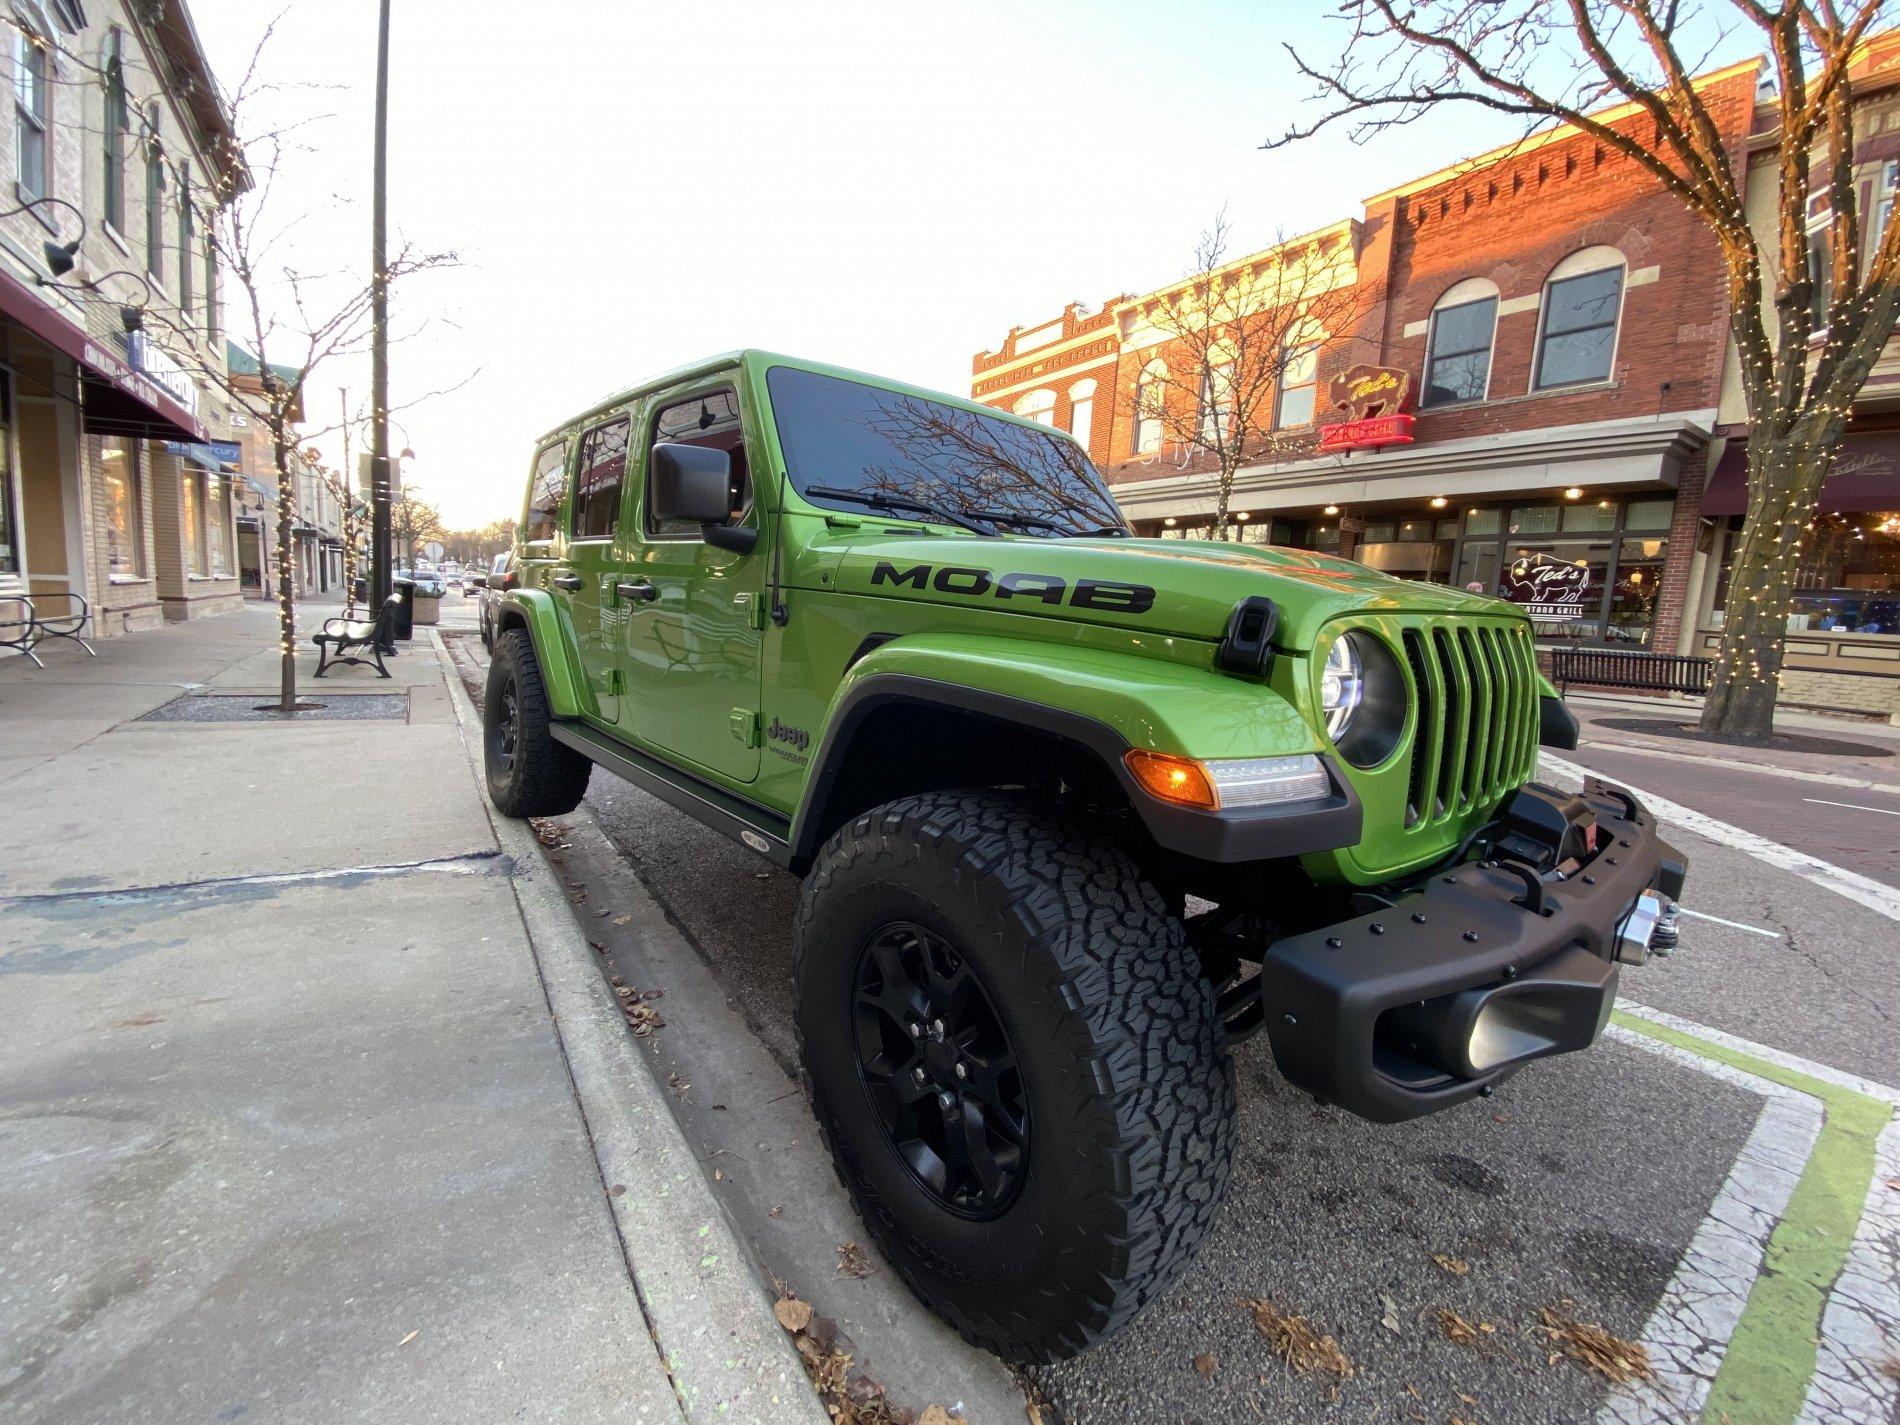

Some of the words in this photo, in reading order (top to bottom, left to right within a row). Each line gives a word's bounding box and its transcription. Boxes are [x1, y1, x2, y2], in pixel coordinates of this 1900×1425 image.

[1346, 372, 1399, 402] Ted's
[869, 561, 1158, 614] MOAB
[1531, 565, 1580, 583] Ted's
[1556, 606, 1583, 615] GRILL
[767, 715, 810, 752] Jeep
